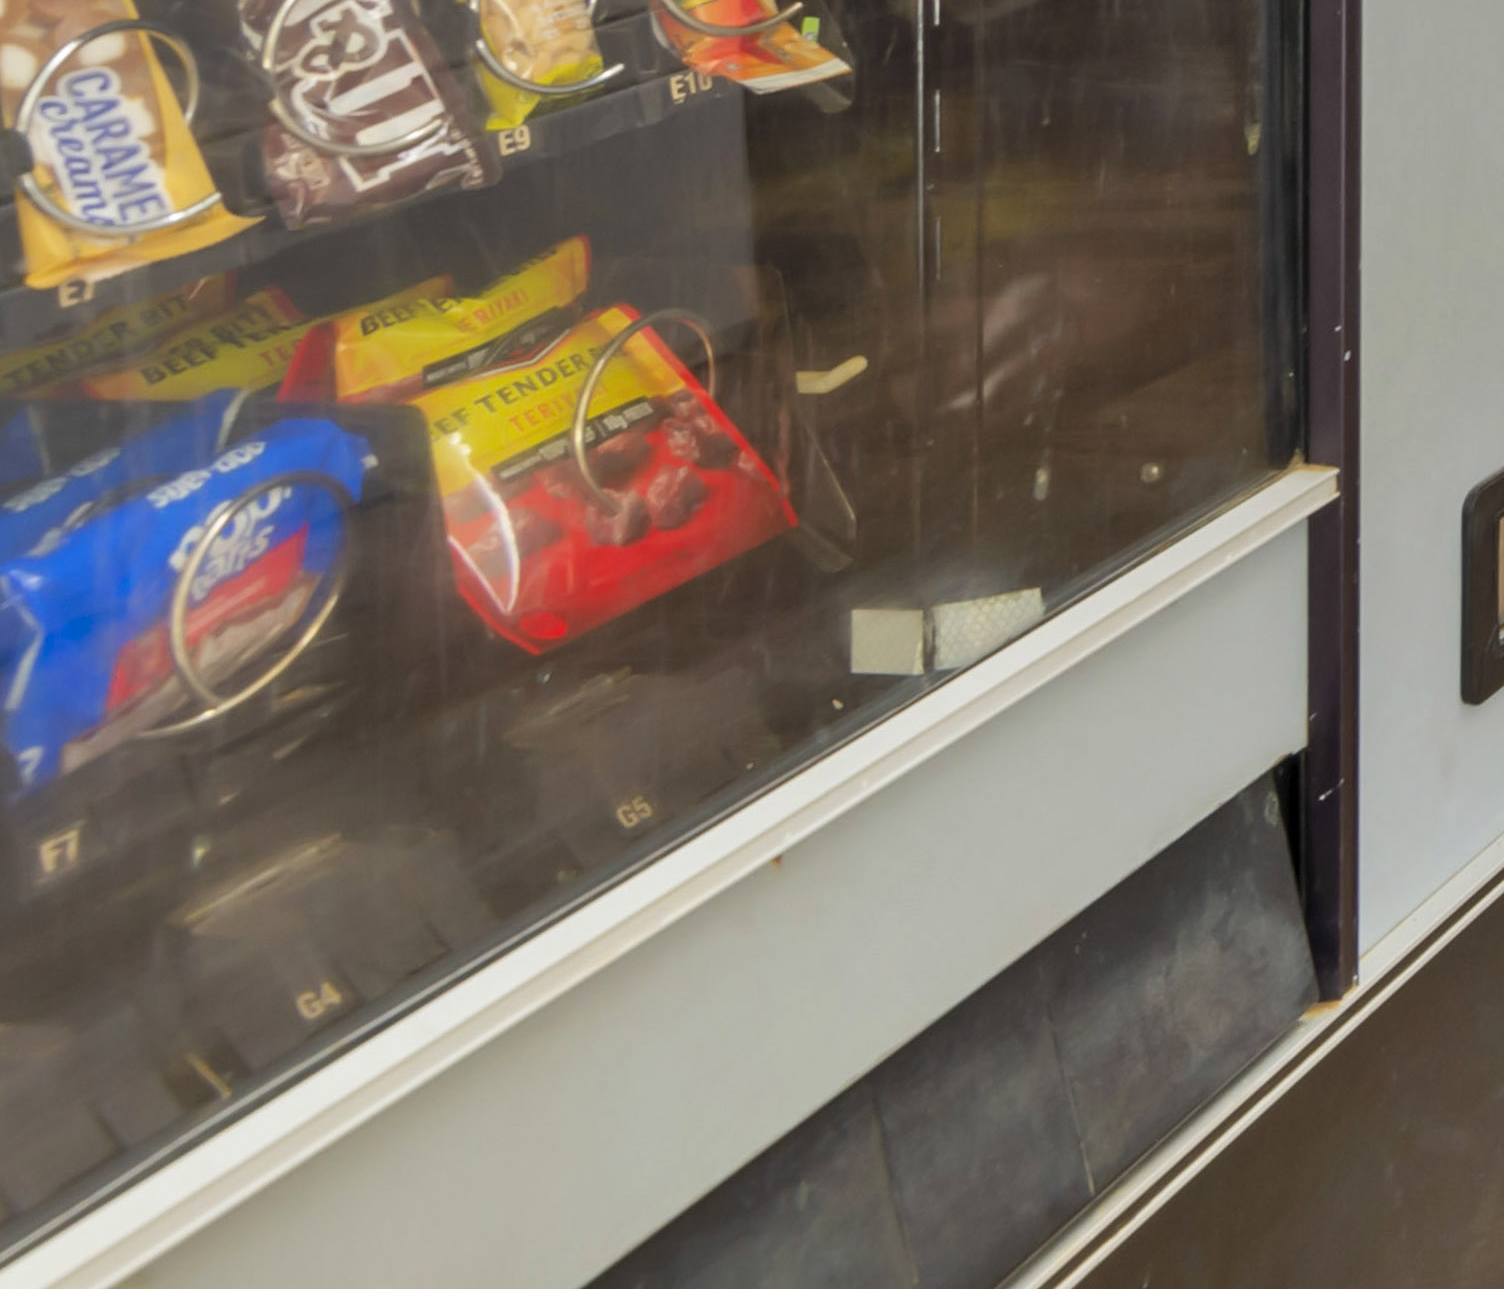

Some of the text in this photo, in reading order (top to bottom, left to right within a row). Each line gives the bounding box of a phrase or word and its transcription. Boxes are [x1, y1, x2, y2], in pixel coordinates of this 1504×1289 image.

[668, 69, 714, 105] E10
[67, 70, 167, 225] CARAME
[499, 124, 532, 157] E9
[473, 349, 589, 415] TENDER
[615, 795, 655, 830] G5
[40, 828, 81, 874] F7
[296, 981, 343, 1021] G4
